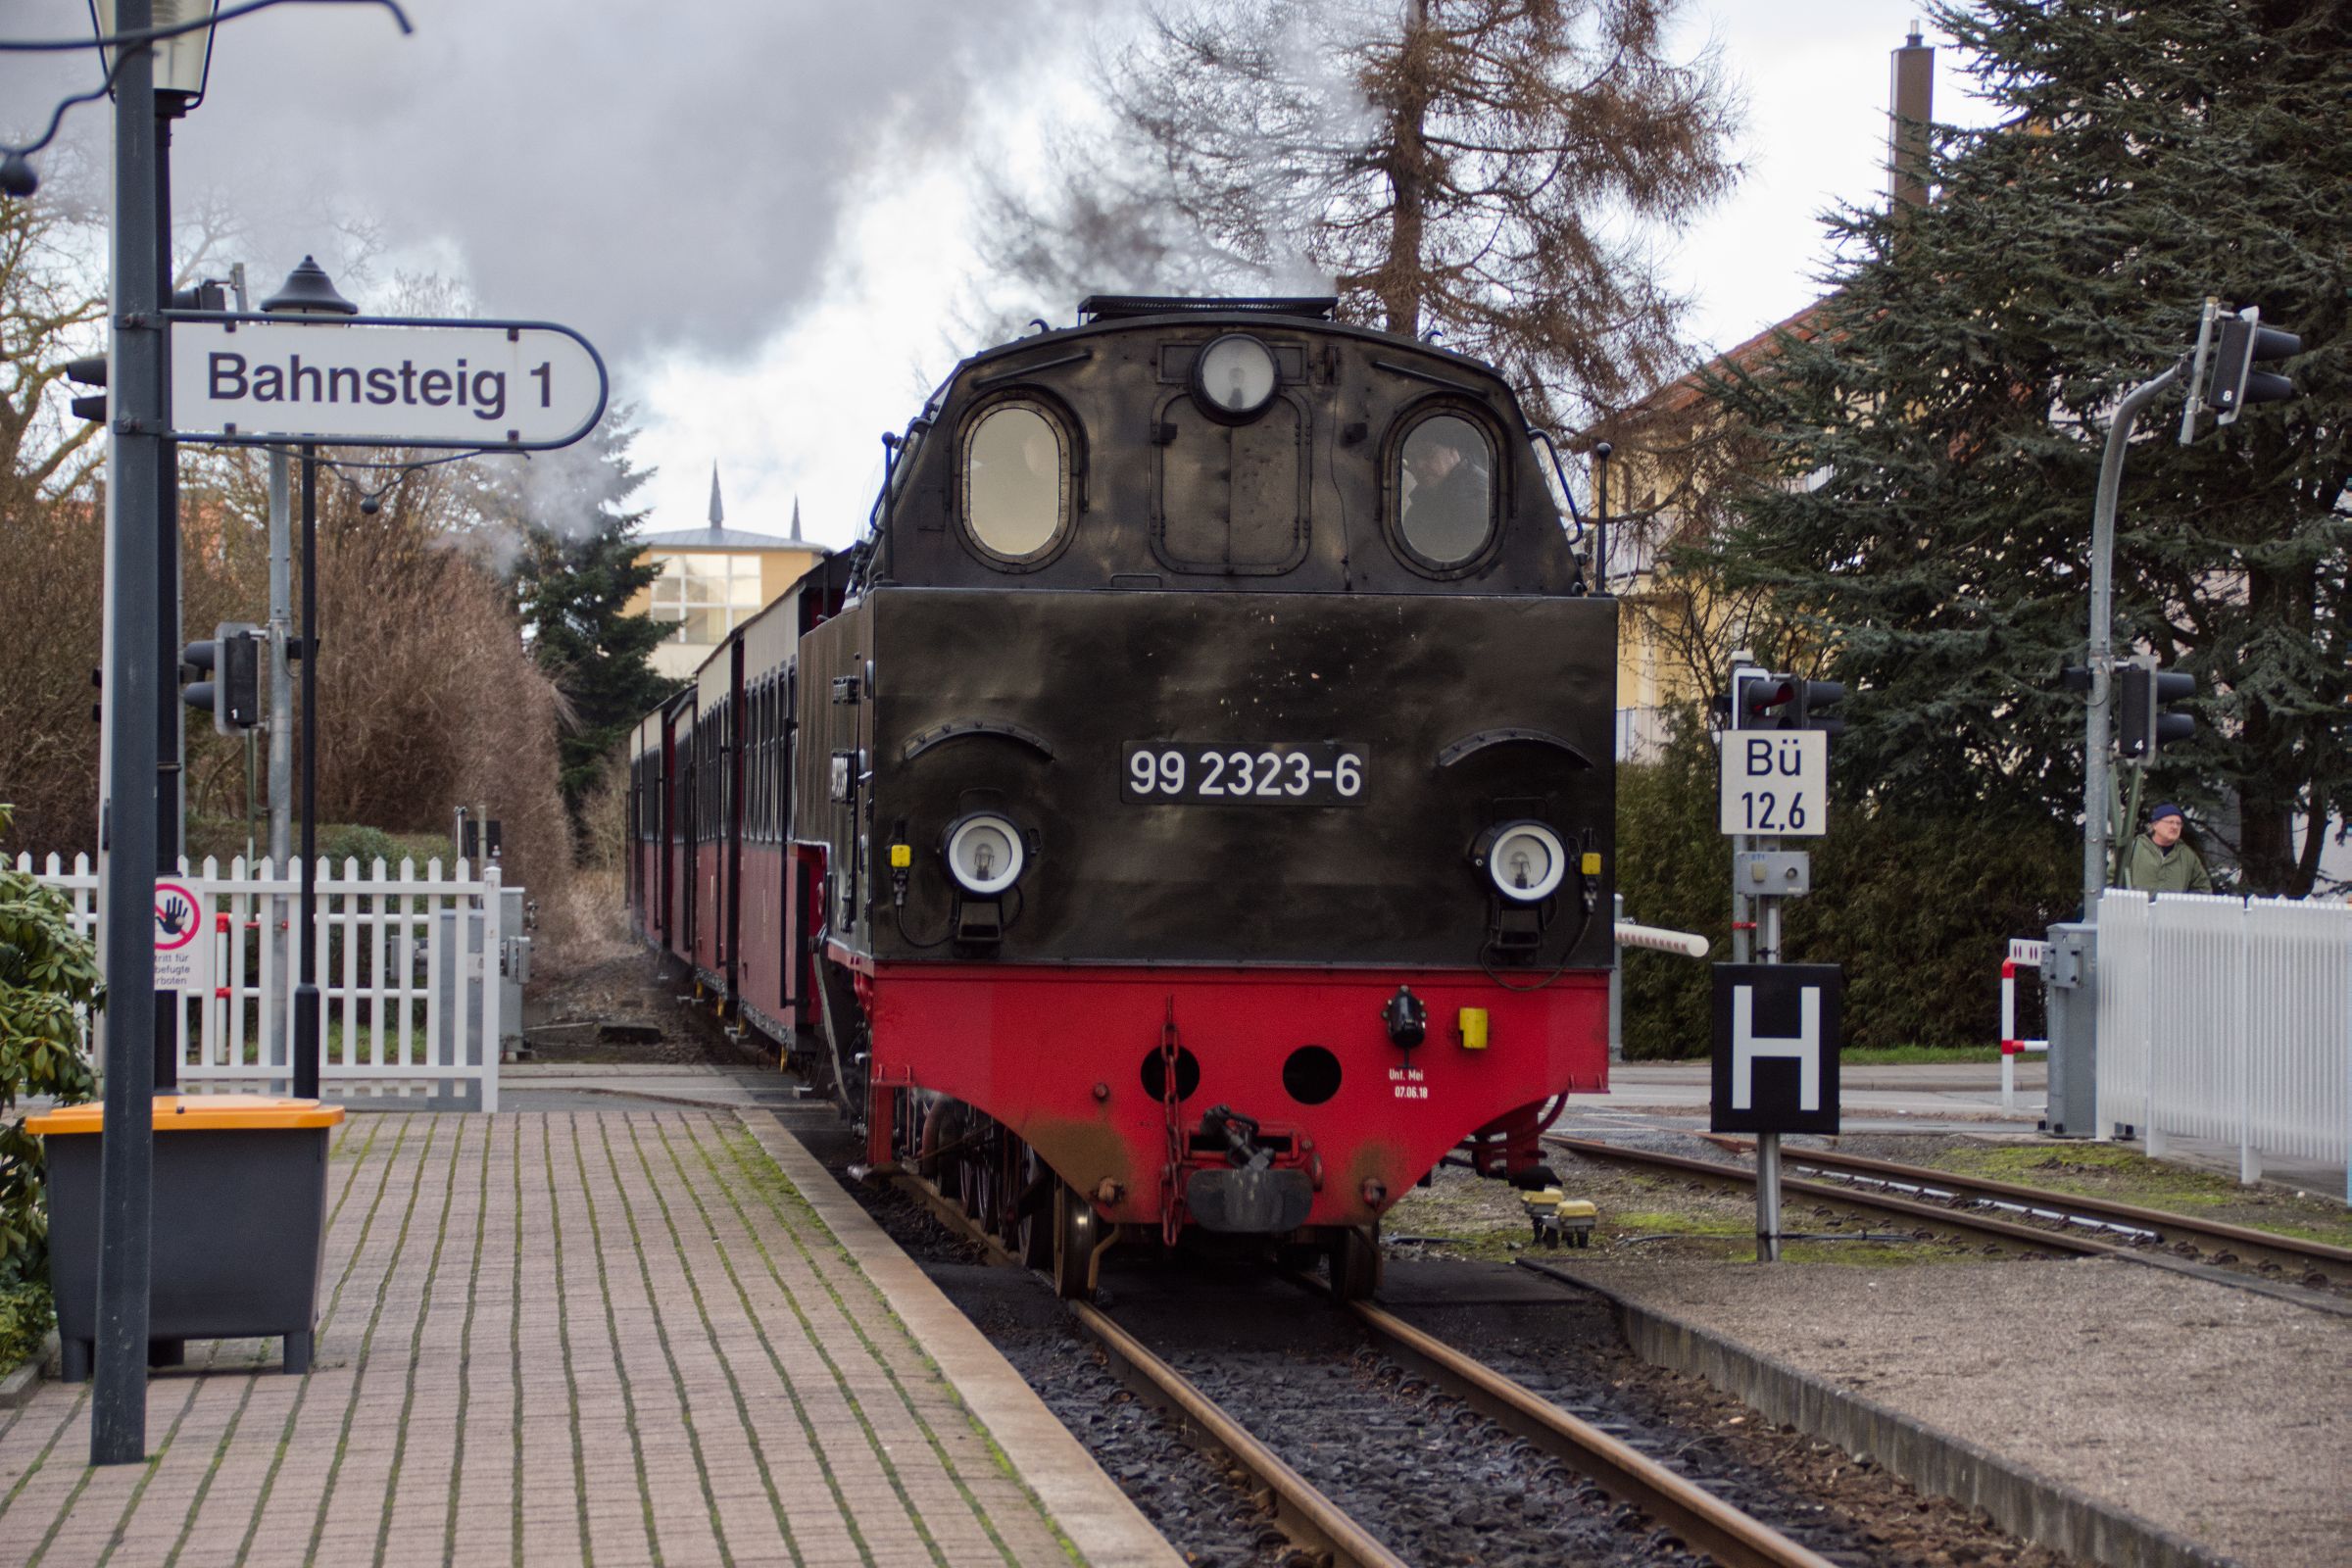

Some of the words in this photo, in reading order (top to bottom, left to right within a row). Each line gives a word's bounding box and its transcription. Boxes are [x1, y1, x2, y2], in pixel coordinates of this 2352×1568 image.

[209, 352, 506, 420] Bahnsteig
[530, 362, 551, 408] 1
[2223, 390, 2232, 402] 8
[230, 708, 238, 720] 1
[1746, 739, 1801, 776] Bü
[2134, 739, 2144, 751] 4
[1130, 750, 1186, 794] 99
[1199, 751, 1362, 796] 2323-6
[1741, 792, 1805, 832] 12,6
[1733, 985, 1821, 1110] H
